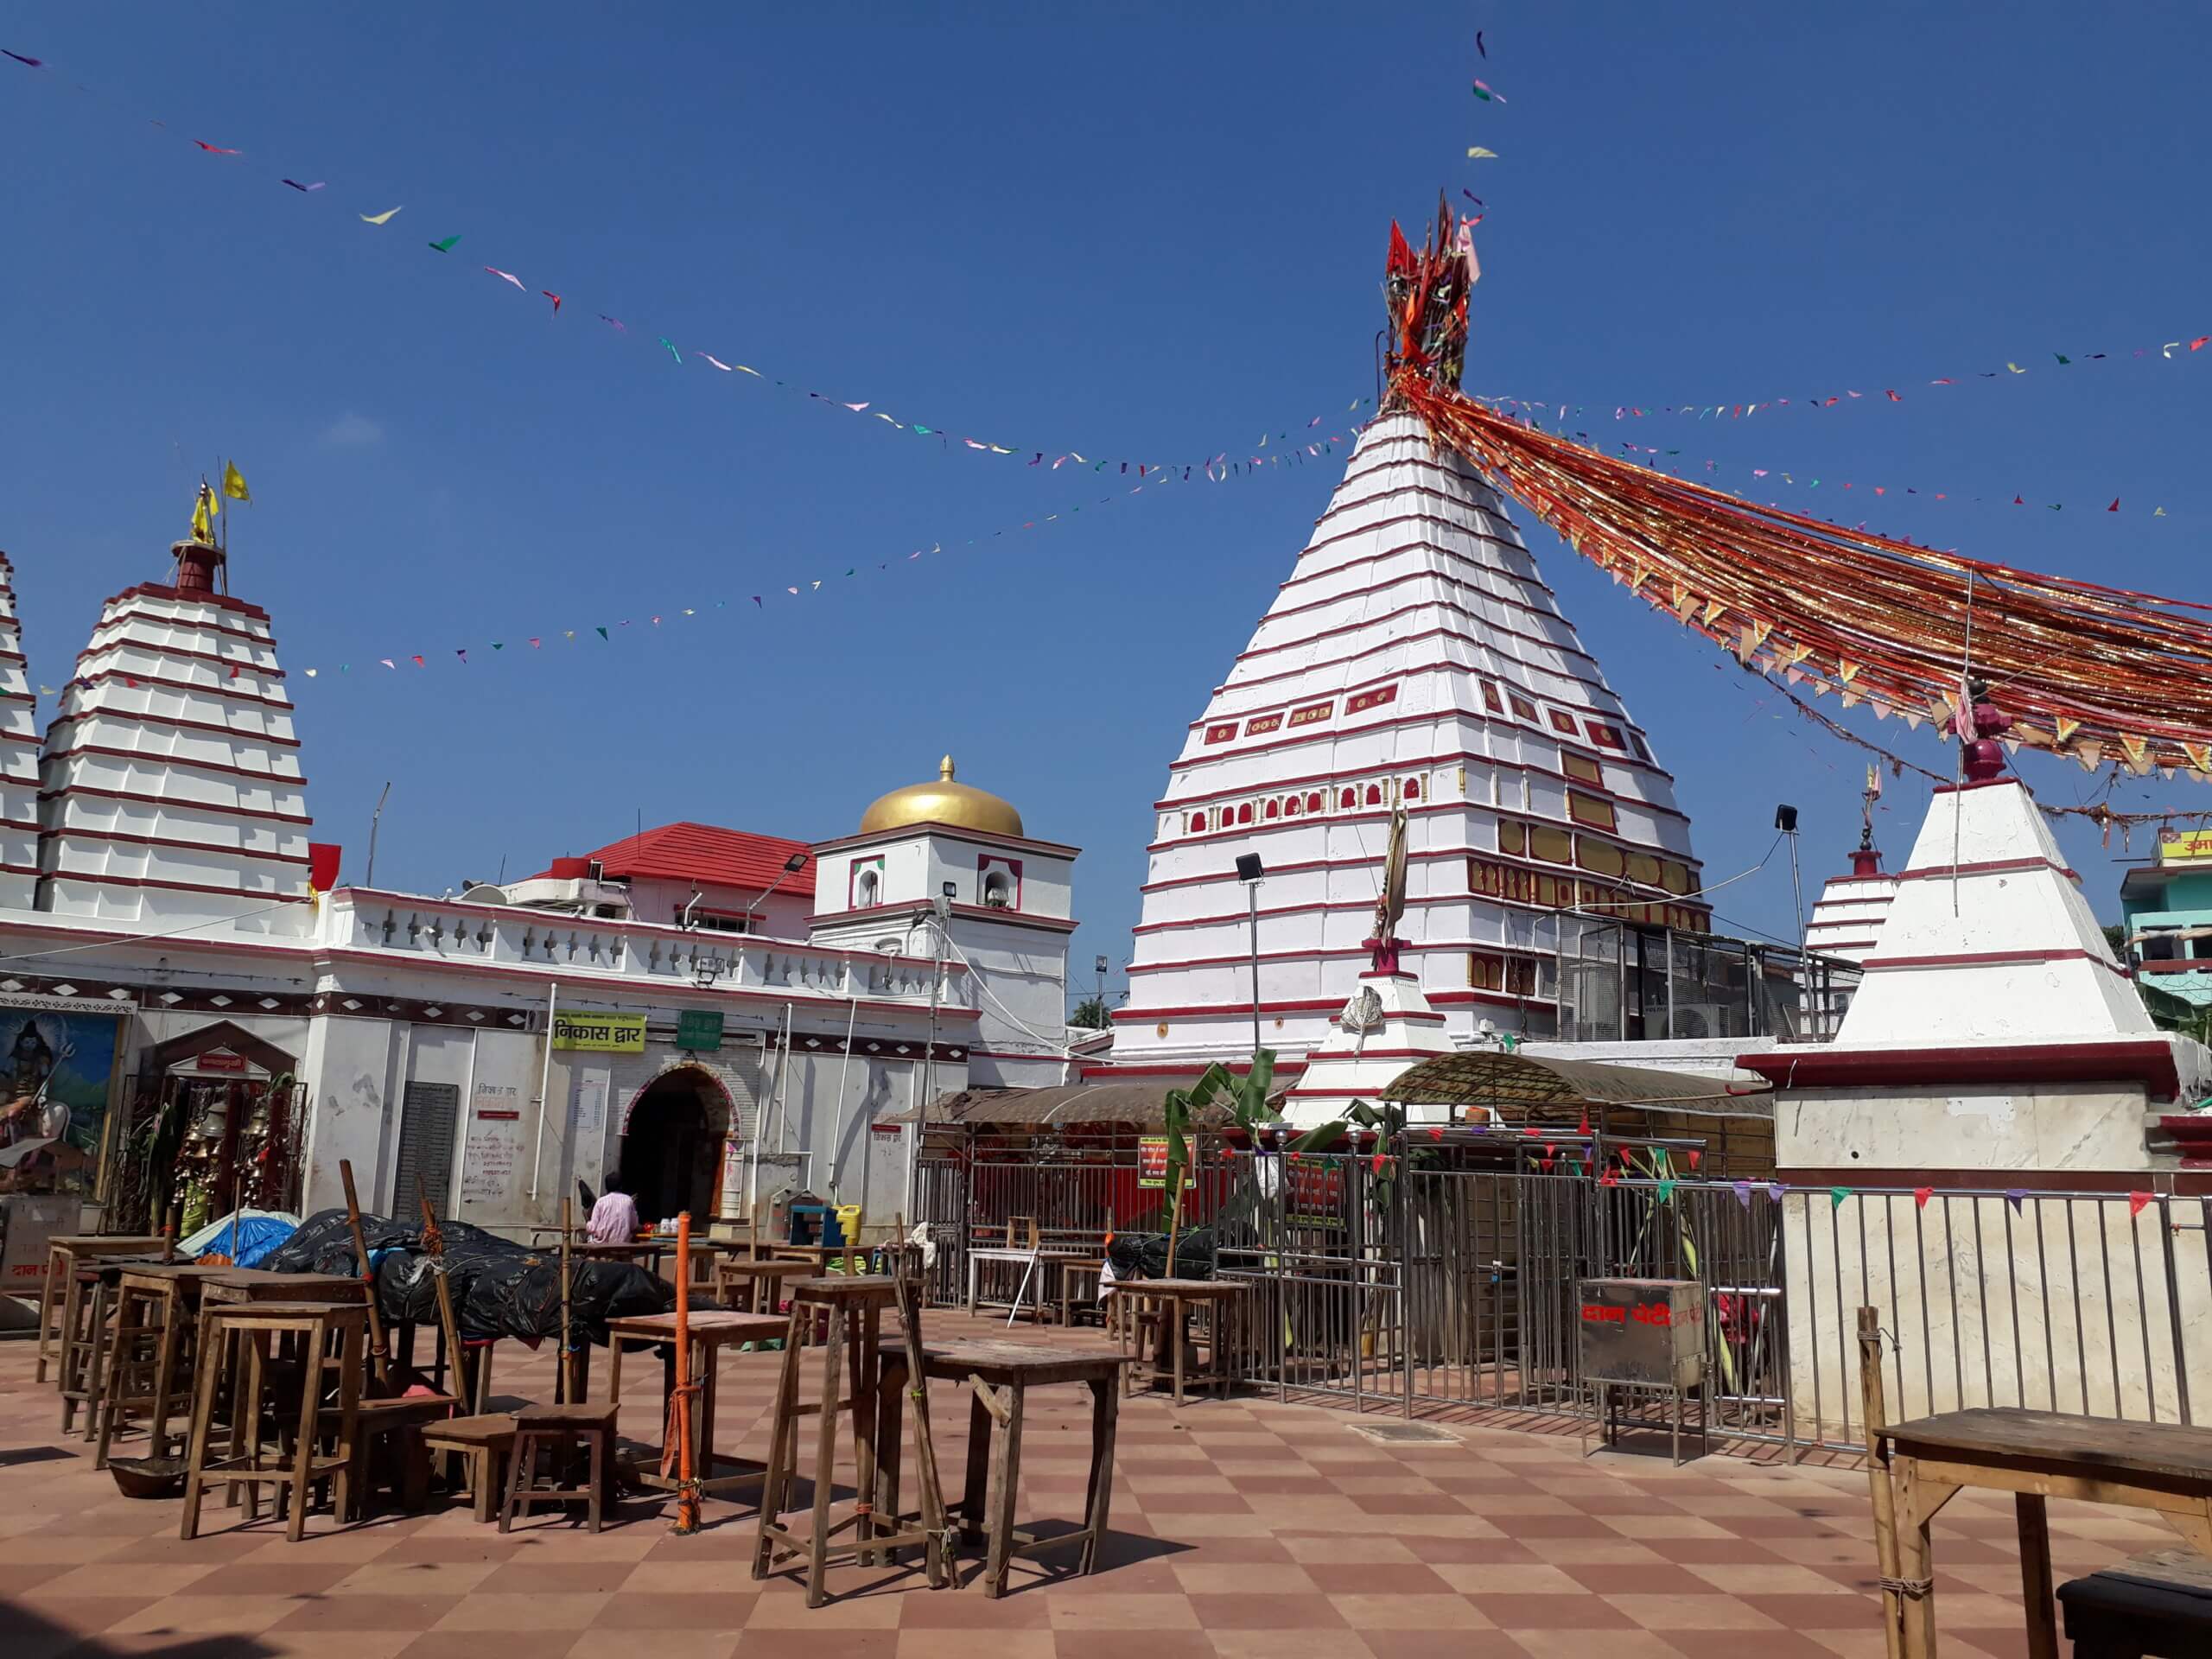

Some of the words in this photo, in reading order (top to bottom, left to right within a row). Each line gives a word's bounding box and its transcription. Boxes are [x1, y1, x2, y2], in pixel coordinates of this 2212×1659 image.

[554, 1019, 610, 1040] निकास
[614, 1027, 642, 1044] द्वार
[12, 1264, 39, 1277] दान
[1582, 1305, 1626, 1323] दान
[1632, 1302, 1672, 1326] पेटी
